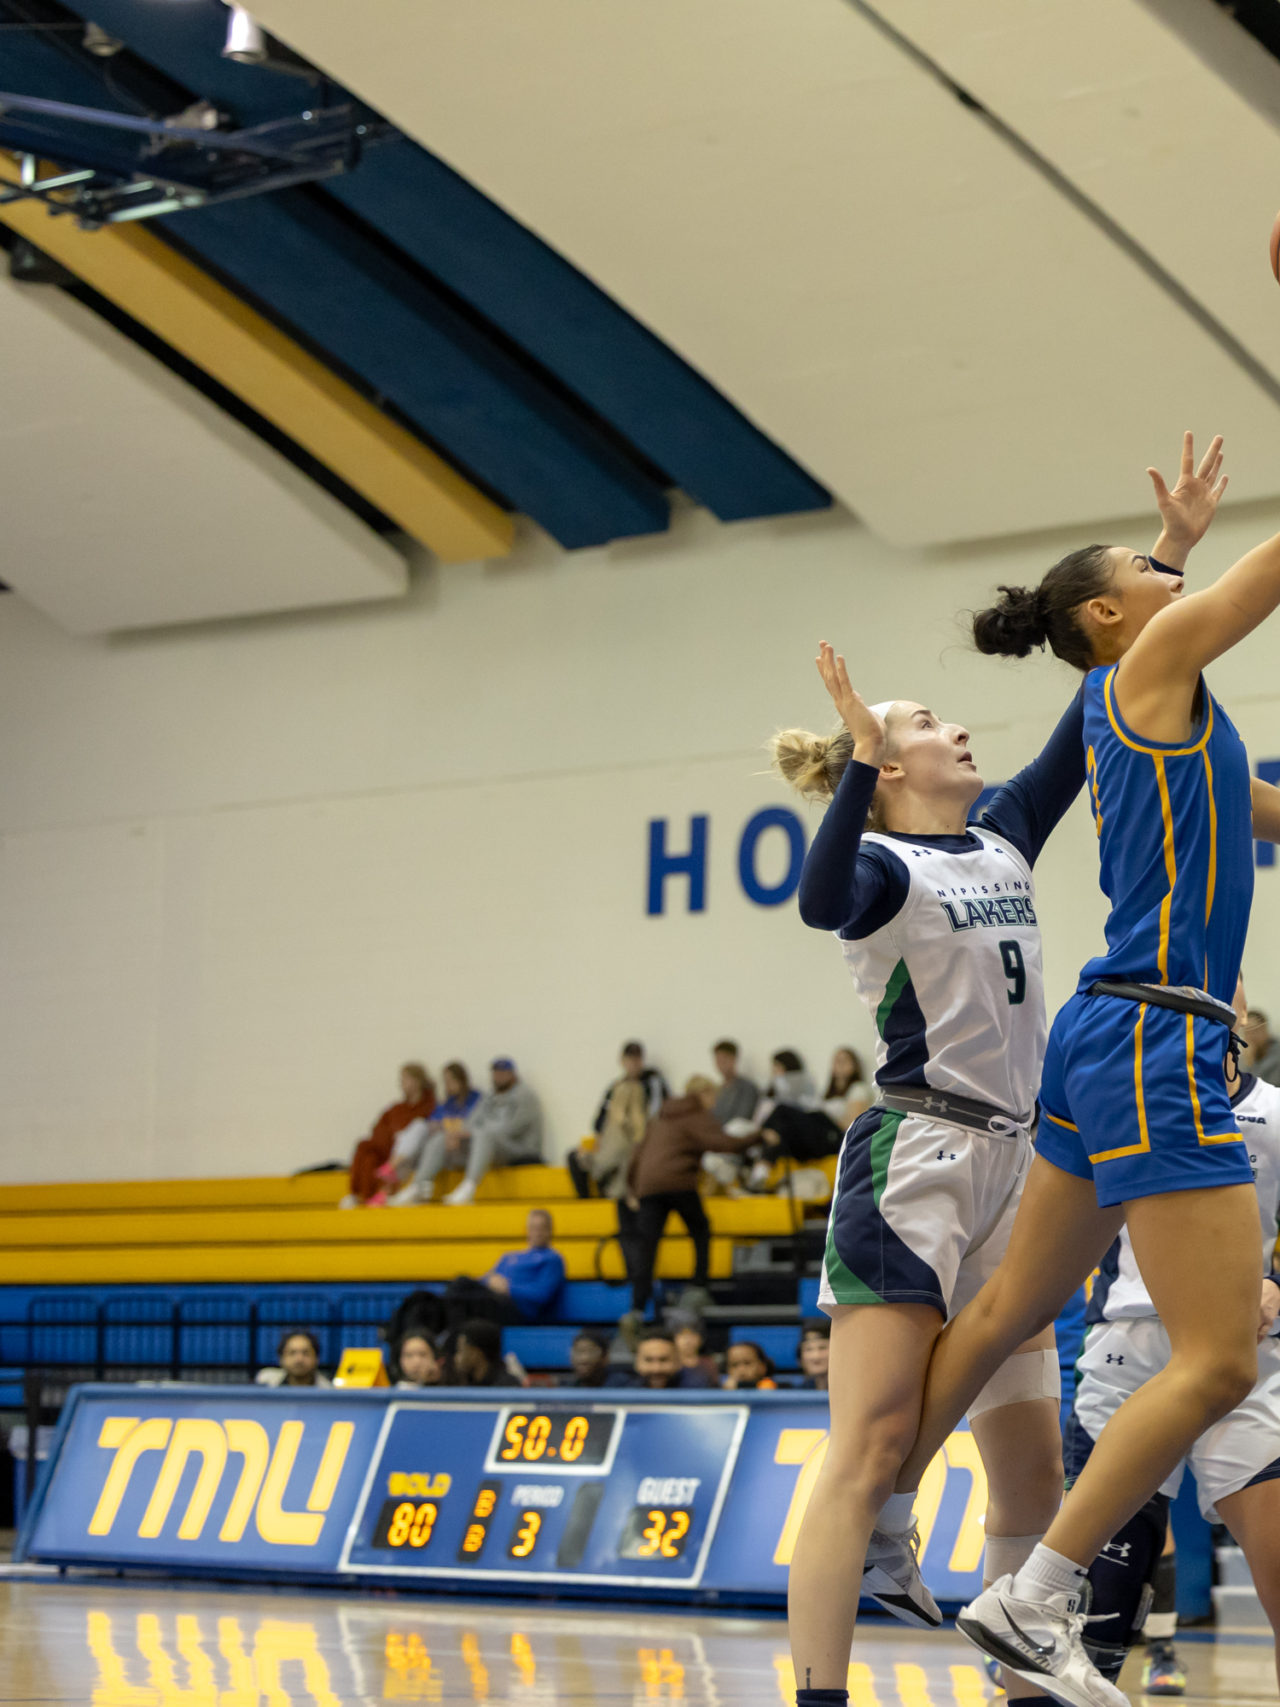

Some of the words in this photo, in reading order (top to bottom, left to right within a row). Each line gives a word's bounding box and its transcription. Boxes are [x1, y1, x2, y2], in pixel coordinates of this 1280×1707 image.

[936, 881, 1030, 898] NIPISSING
[940, 895, 1038, 932] LAKERS
[998, 940, 1026, 1005] 9
[502, 1415, 590, 1461] 50.0
[88, 1417, 355, 1546] TMU
[636, 1477, 700, 1505] GUEST
[387, 1502, 438, 1548] 80
[511, 1511, 542, 1557] 3
[638, 1510, 690, 1557] 32
